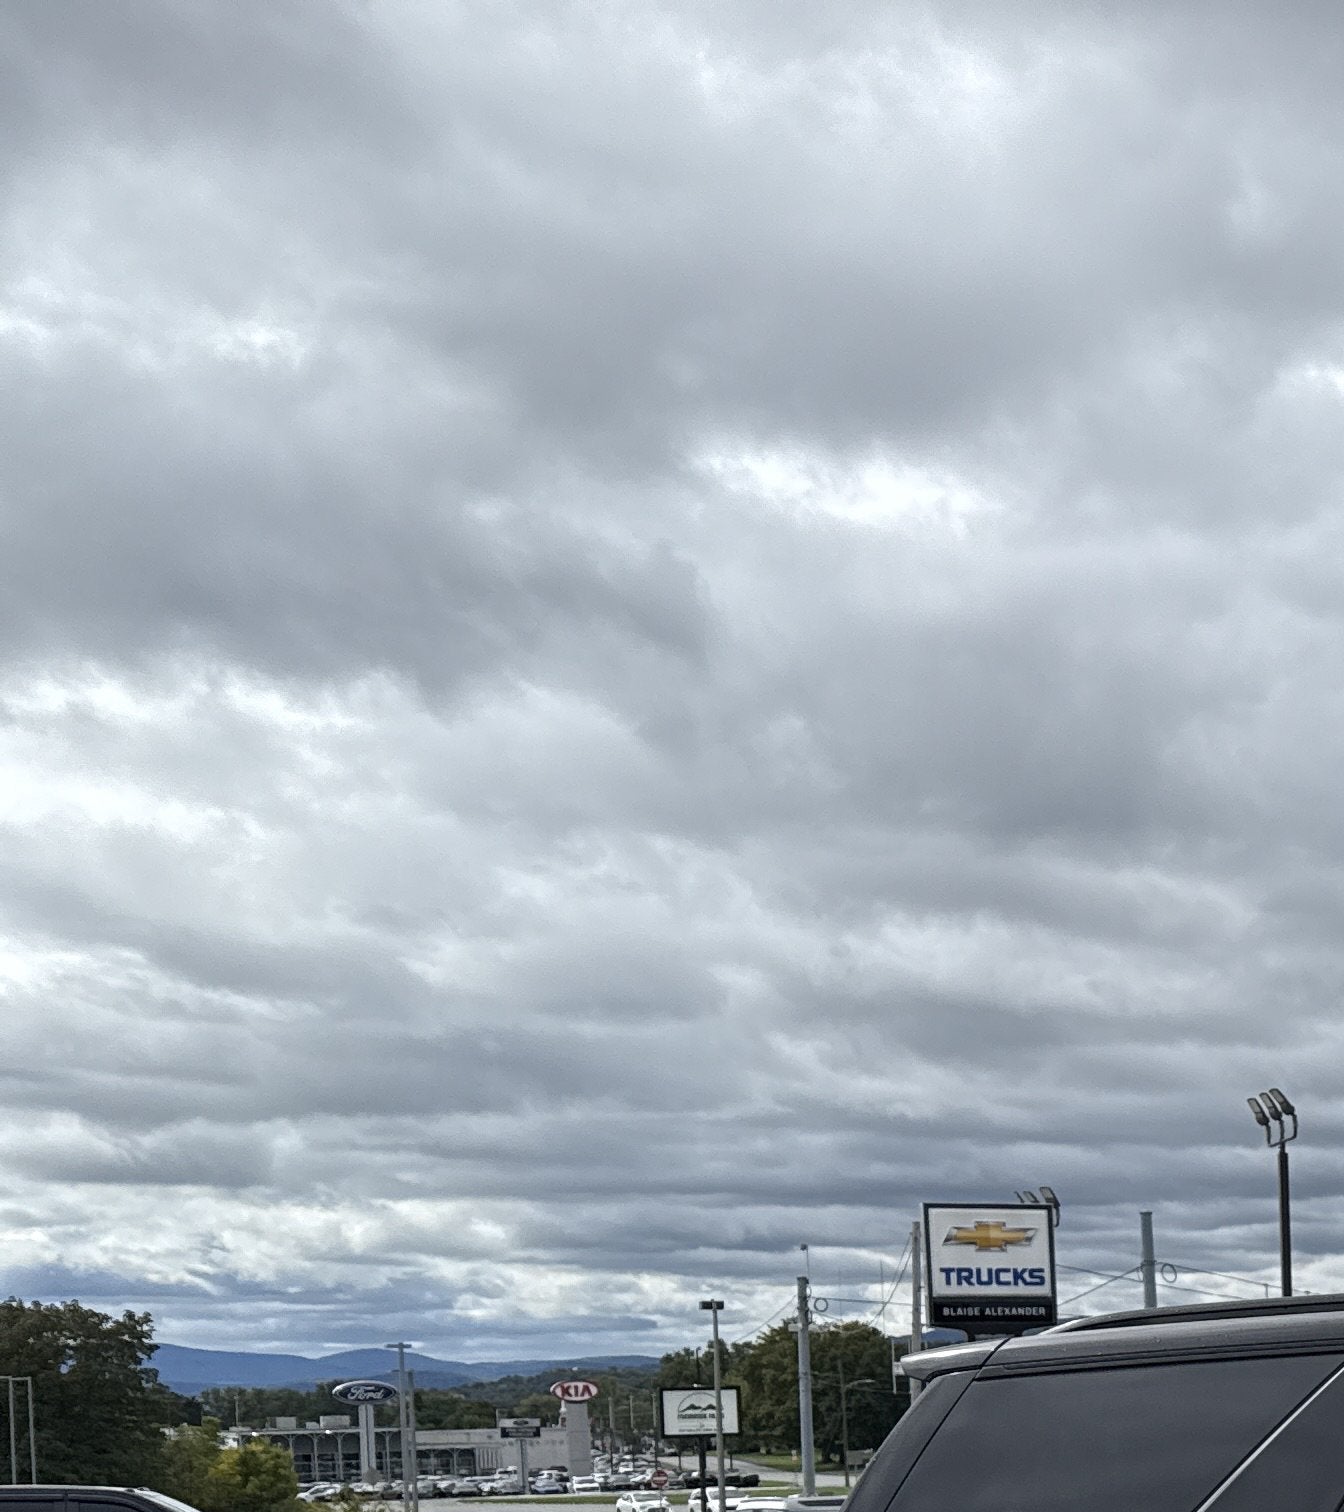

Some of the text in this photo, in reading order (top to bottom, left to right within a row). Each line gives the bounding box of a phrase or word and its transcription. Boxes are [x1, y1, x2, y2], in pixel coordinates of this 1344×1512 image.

[940, 1267, 1046, 1286] TRUCKS
[942, 1306, 1046, 1316] BLAISE ALEXANDER
[347, 1385, 384, 1400] Ford
[560, 1385, 593, 1397] KIA
